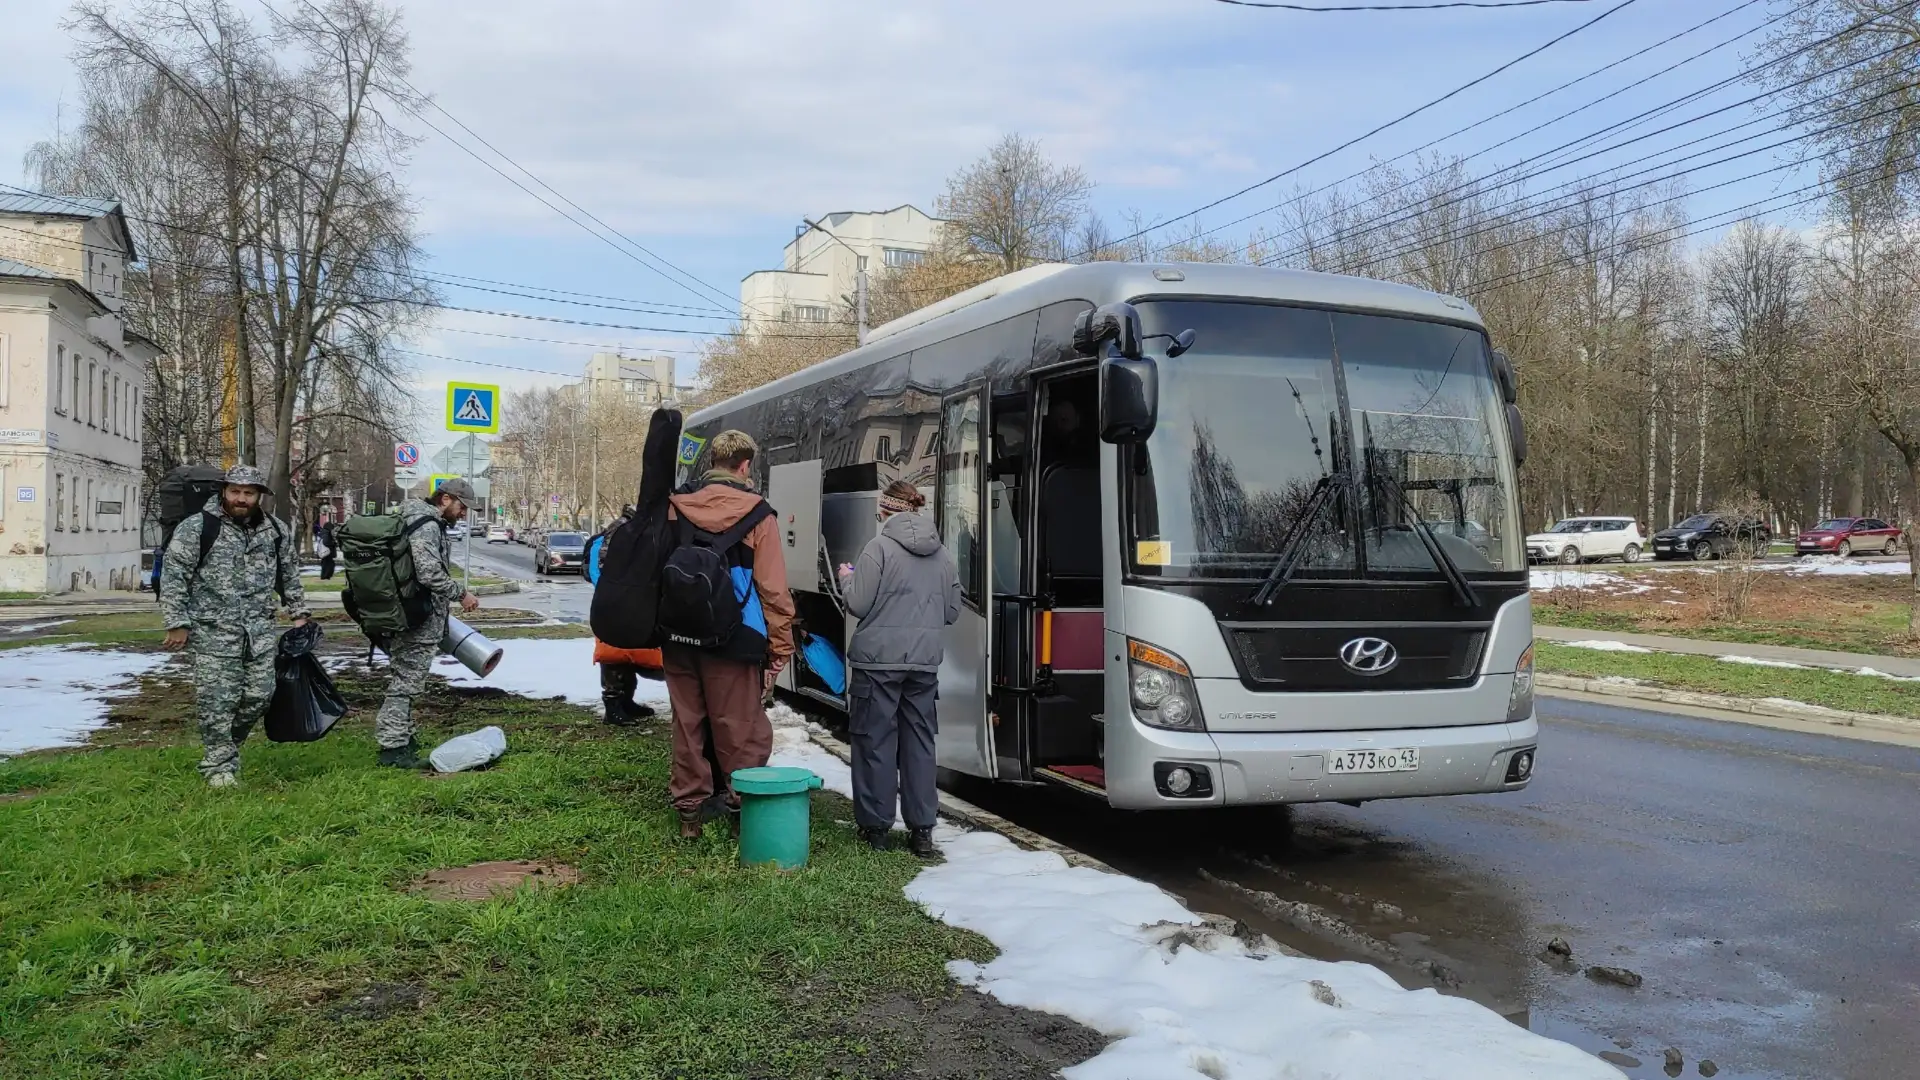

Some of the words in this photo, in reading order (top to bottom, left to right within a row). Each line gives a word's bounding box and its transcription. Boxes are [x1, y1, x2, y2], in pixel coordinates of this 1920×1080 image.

[1140, 545, 1166, 563] ПРОПУ
[1219, 711, 1277, 720] UNIVERSE
[1401, 750, 1415, 763] 43
